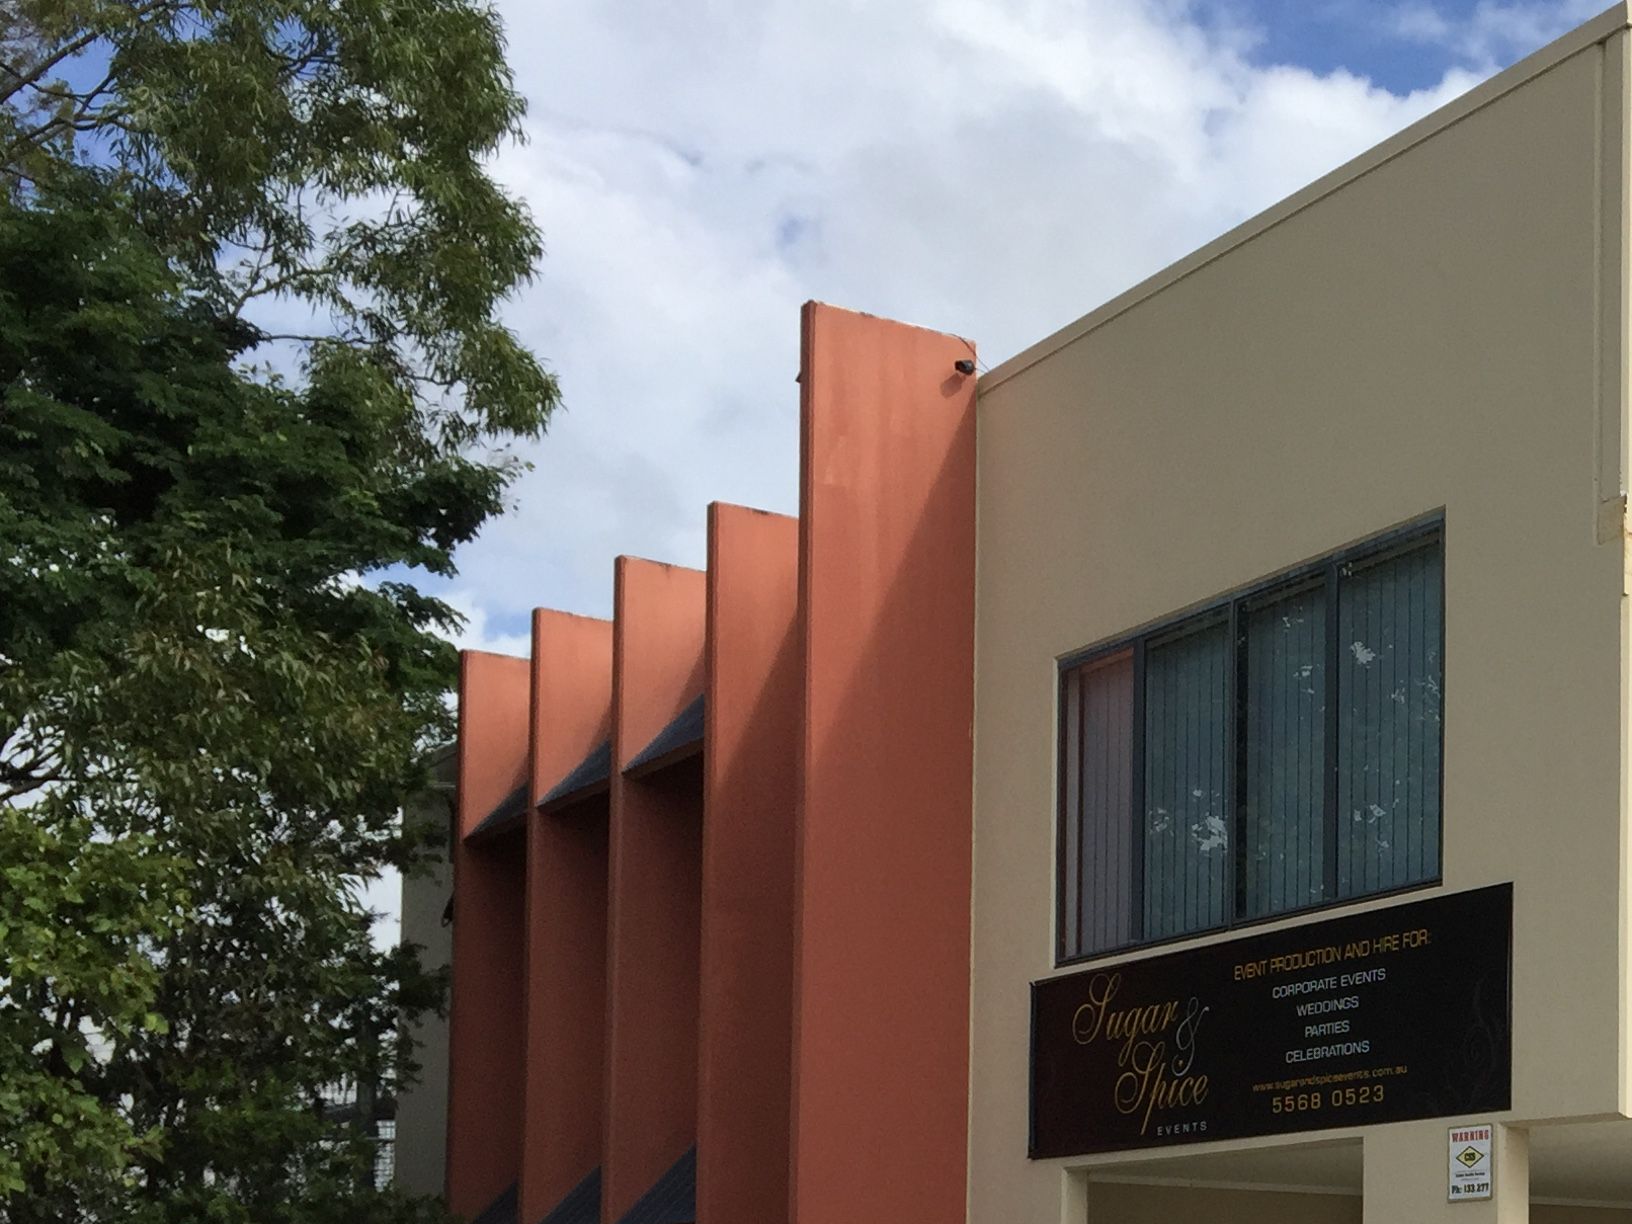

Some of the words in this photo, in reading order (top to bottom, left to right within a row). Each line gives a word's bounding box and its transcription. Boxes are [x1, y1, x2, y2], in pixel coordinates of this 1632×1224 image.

[1234, 960, 1267, 981] EVENT
[1270, 946, 1343, 974] PRODUCTION
[1344, 940, 1370, 960] AND
[1372, 934, 1400, 955] HIRE
[1272, 977, 1338, 999] CORPORATE
[1340, 967, 1386, 988] EVENTS
[1296, 996, 1360, 1017] WEDDINGS
[1072, 972, 1179, 1068] Sugar
[1171, 996, 1209, 1077] &
[1304, 1020, 1351, 1038] PARTIES
[1286, 1040, 1370, 1064] CELEBRATIONS
[1114, 1041, 1209, 1136] Spice
[1272, 1092, 1321, 1114] 5568
[1331, 1085, 1385, 1107] 0523
[1157, 1121, 1208, 1136] EVENTS
[1451, 1129, 1489, 1143] WARNING
[1464, 1183, 1475, 1194] 133
[1476, 1182, 1489, 1193] 277
